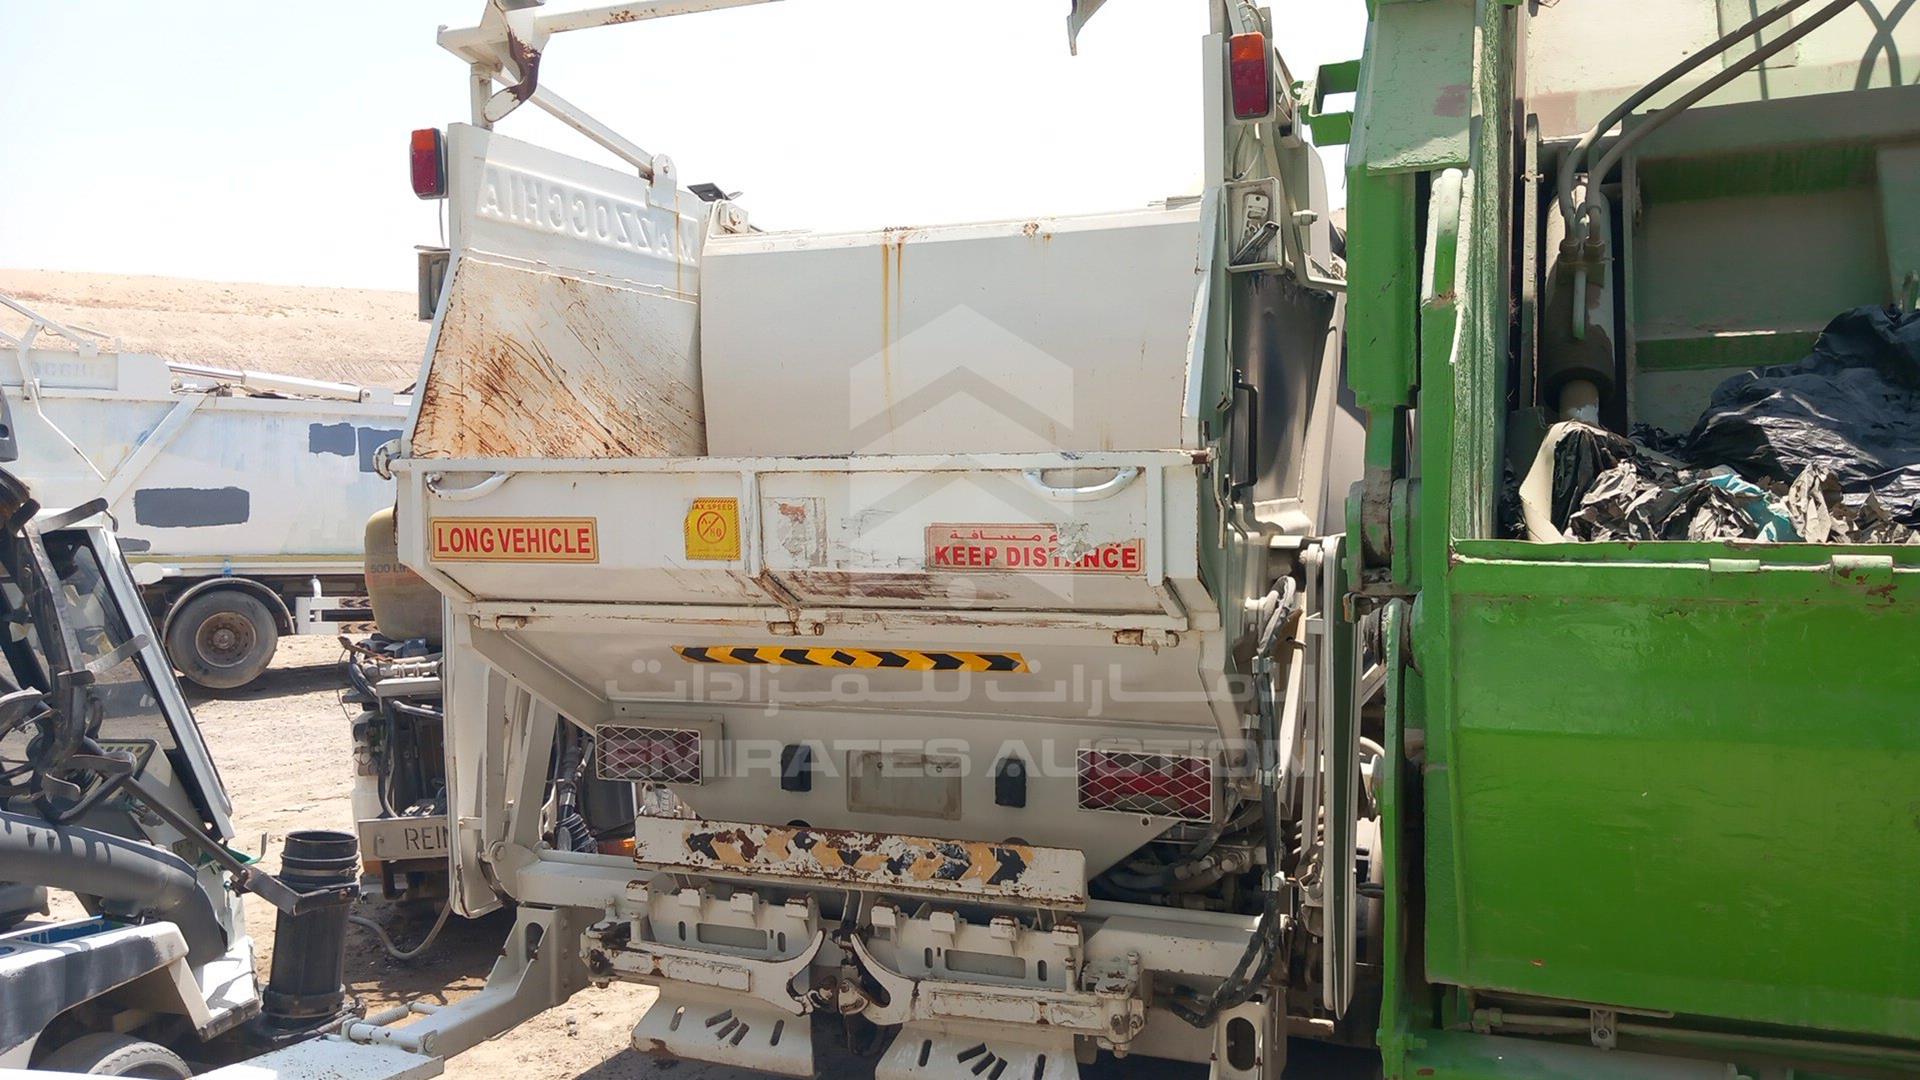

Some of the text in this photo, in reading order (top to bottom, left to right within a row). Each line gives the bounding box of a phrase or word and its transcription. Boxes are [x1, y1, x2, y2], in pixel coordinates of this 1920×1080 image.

[438, 528, 591, 554] LONG VEHICLE
[935, 546, 997, 566] KEEP
